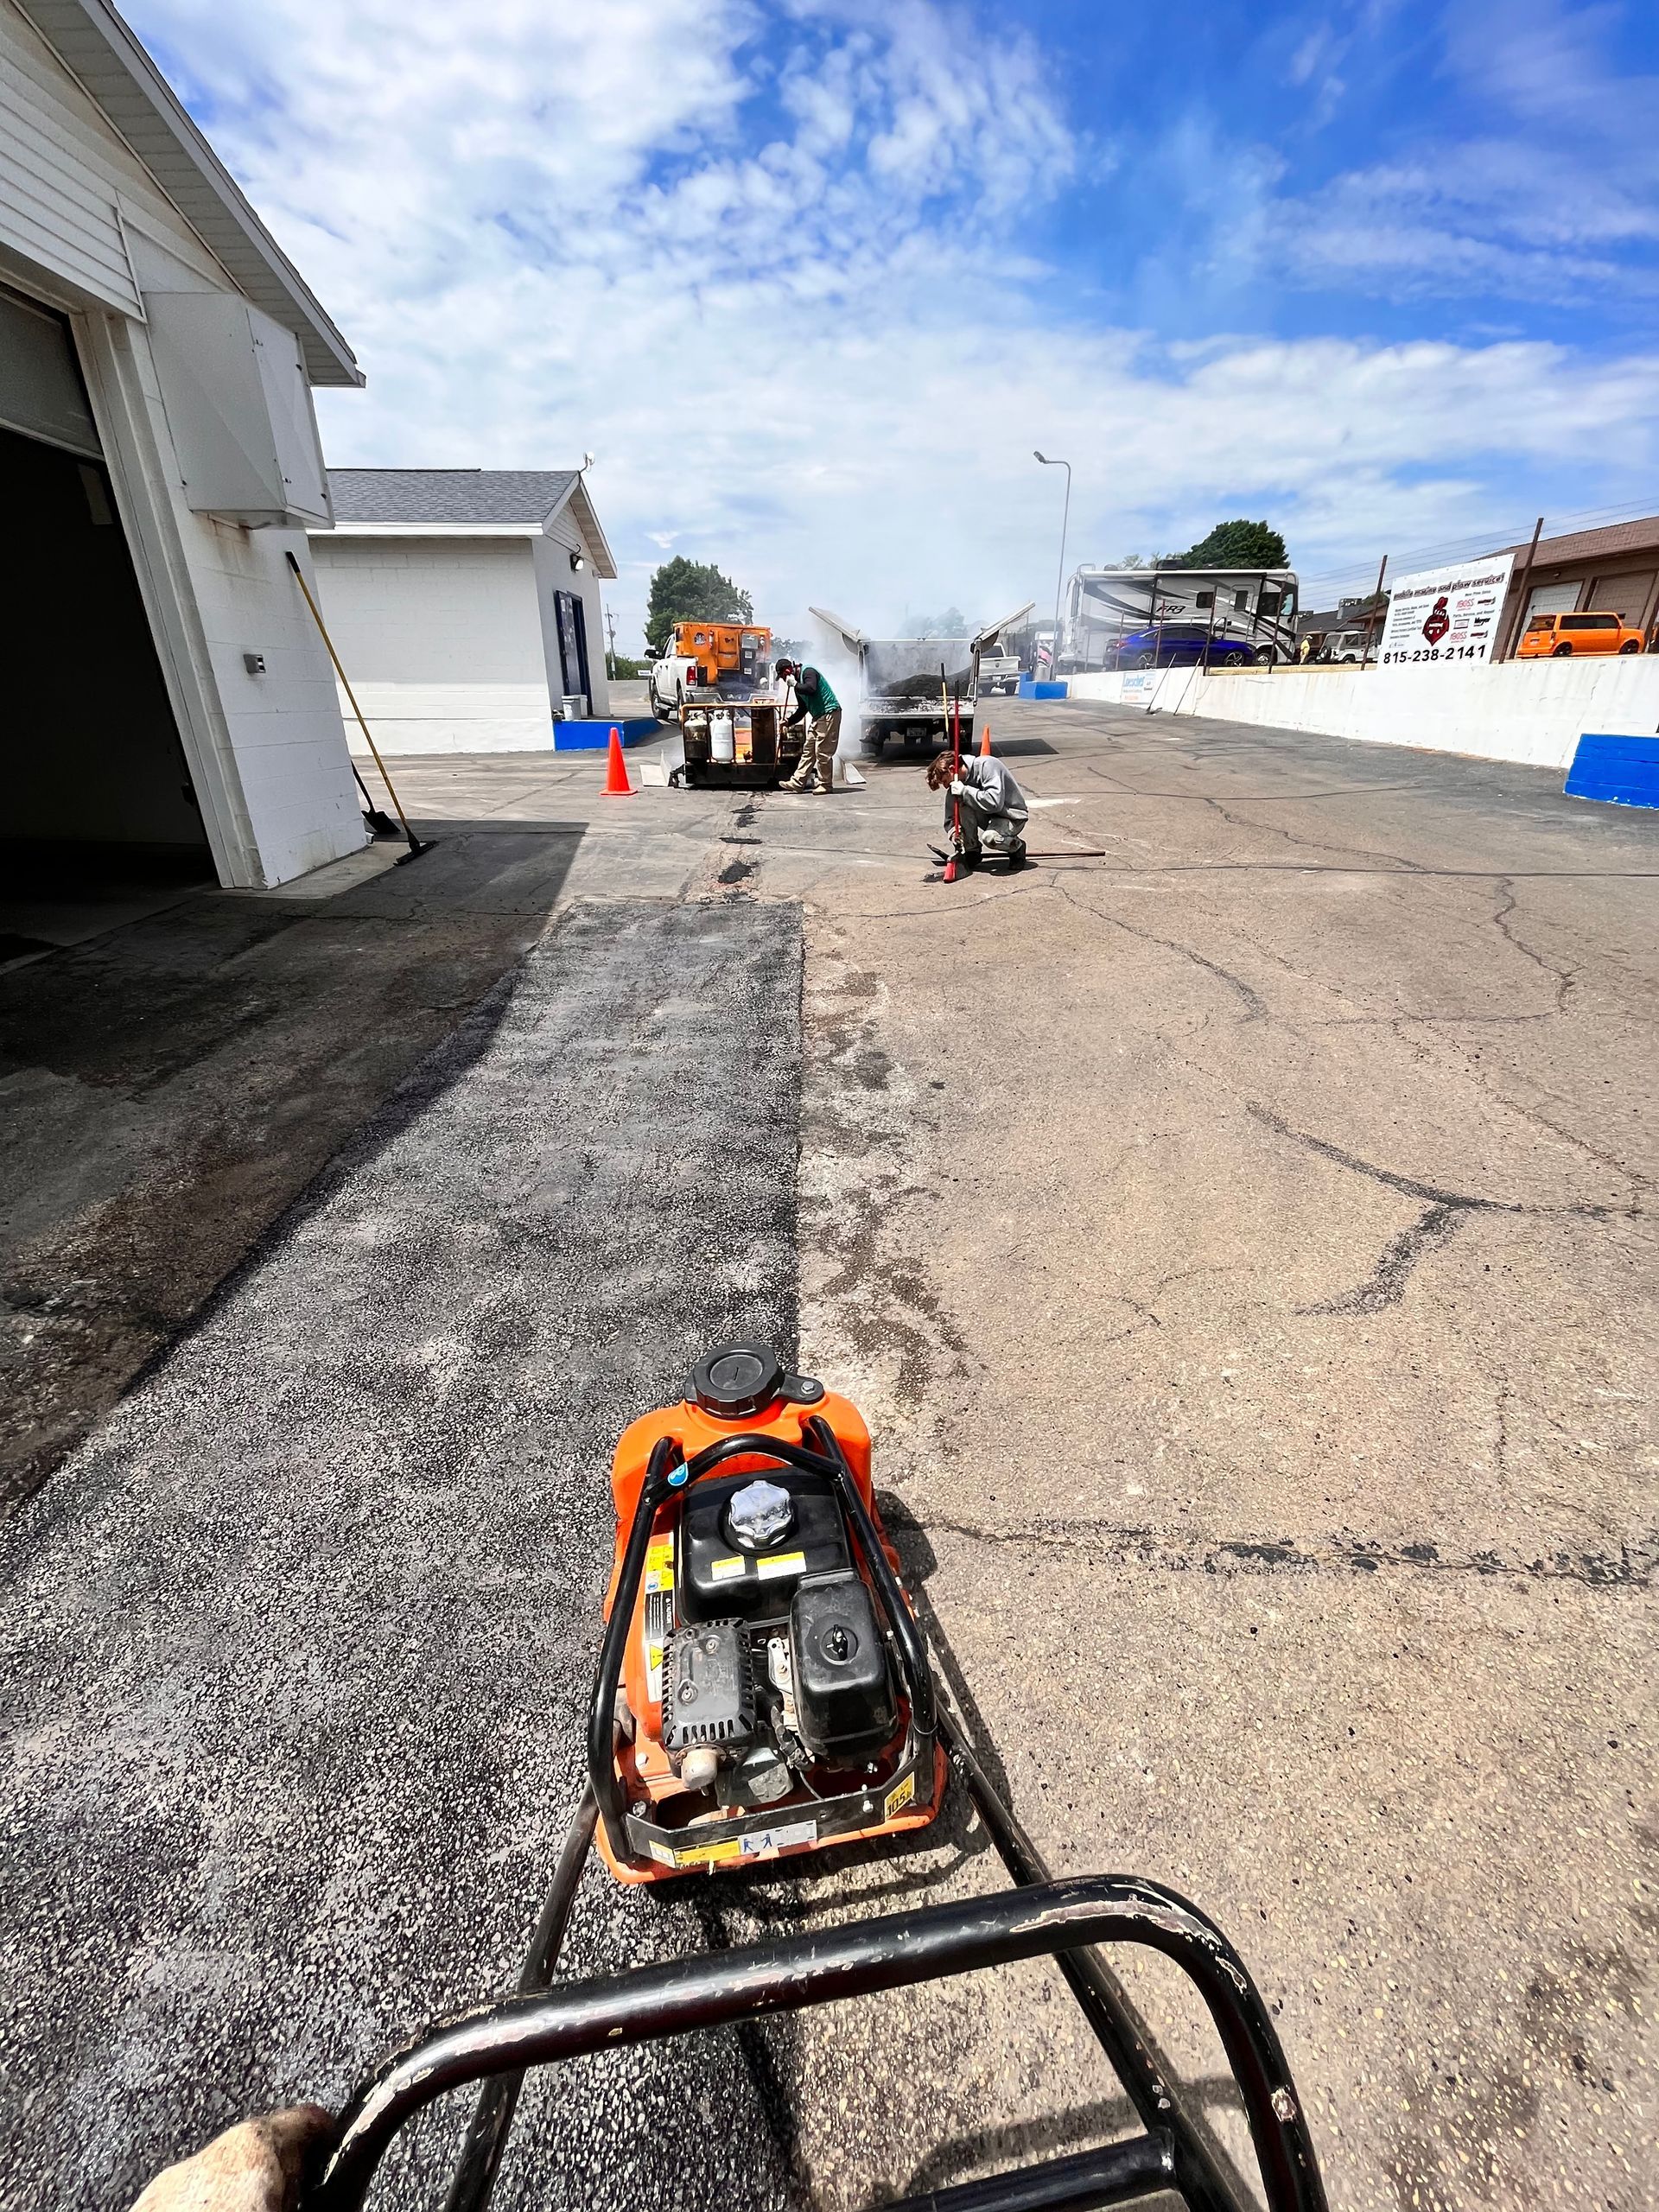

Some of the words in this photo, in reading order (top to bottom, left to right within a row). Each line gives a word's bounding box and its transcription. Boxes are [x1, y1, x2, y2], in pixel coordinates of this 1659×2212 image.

[1438, 582, 1452, 593] and
[1451, 579, 1471, 594] plow
[1383, 645, 1485, 664] 815-238-2141
[887, 1790, 906, 1816] 105
